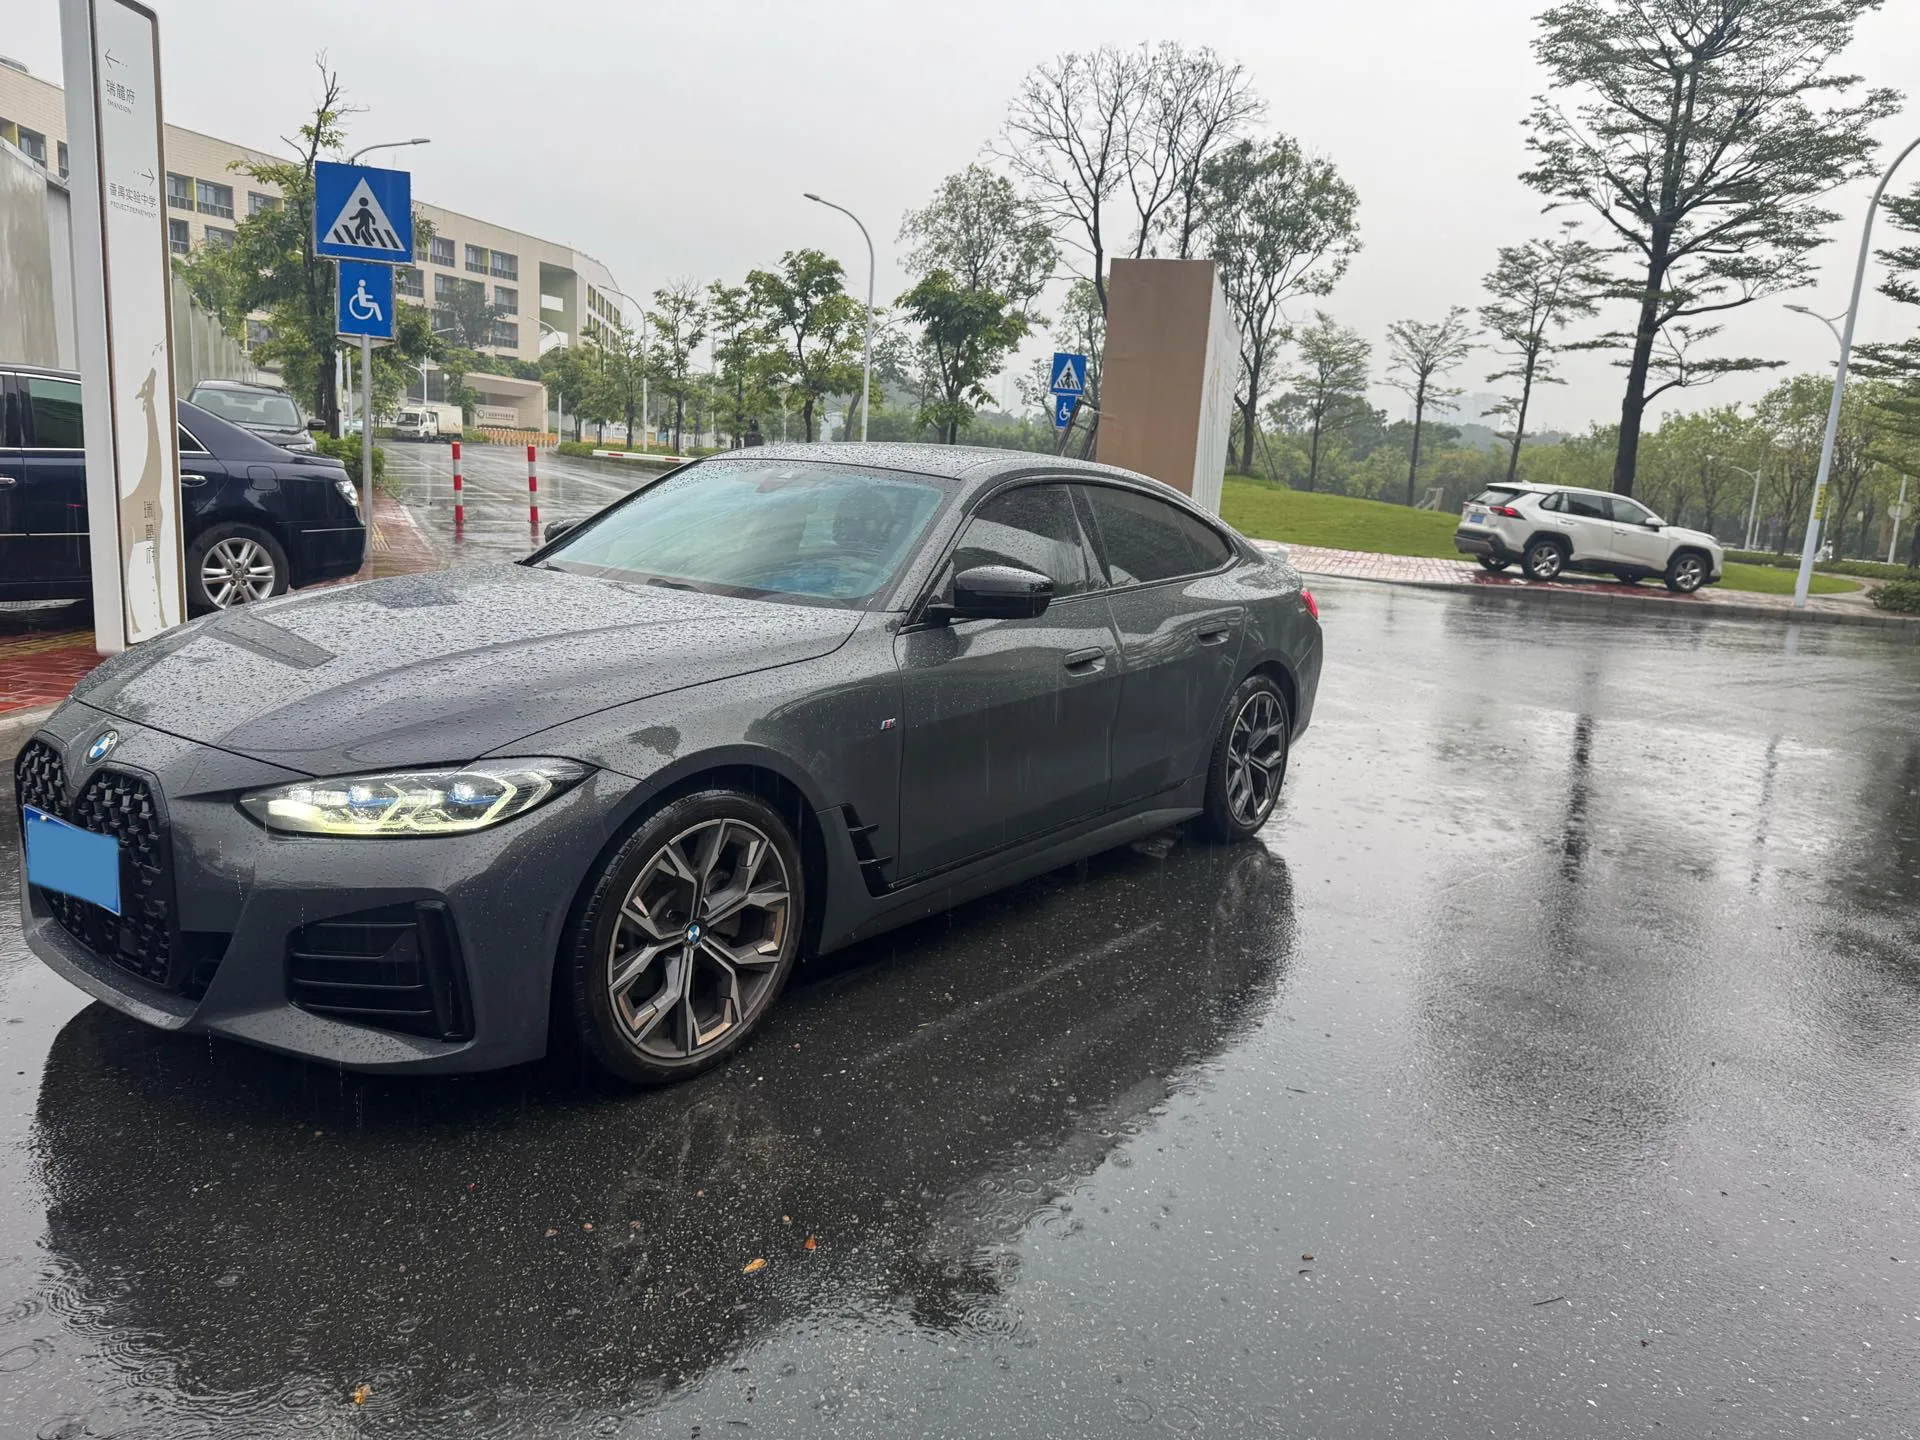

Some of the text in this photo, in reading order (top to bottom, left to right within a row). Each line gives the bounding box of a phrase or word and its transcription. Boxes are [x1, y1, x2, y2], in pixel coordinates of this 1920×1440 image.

[110, 182, 157, 208] 番禺实验中学
